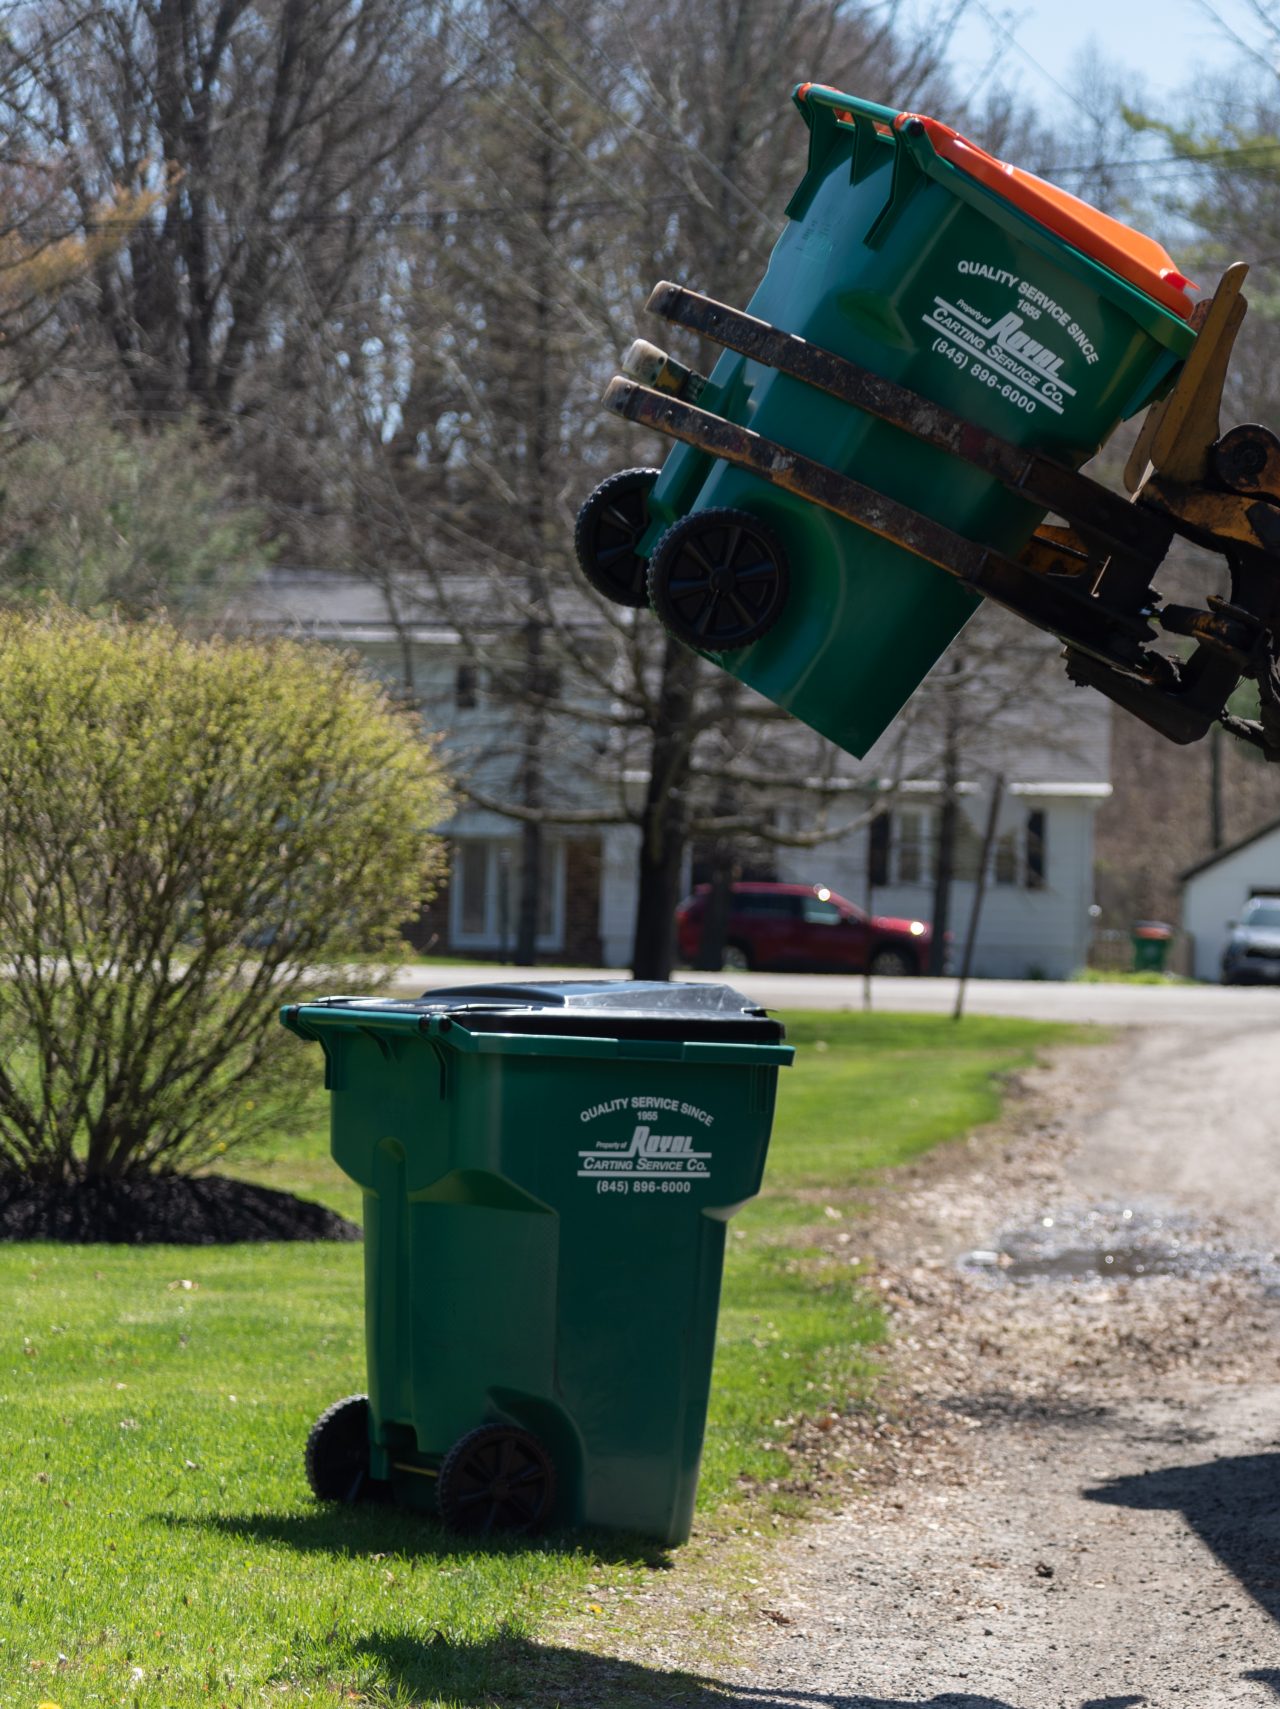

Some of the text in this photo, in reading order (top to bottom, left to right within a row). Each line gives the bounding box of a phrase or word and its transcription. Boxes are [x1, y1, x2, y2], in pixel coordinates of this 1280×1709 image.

[957, 260, 1100, 365] QUALITY SERVICE SINCE
[1016, 299, 1043, 320] 1955
[933, 307, 986, 350] CARTING
[986, 344, 1041, 387] SERVICE
[956, 299, 1065, 377] Property of ROYAL
[931, 337, 1037, 414] (845) 896-6000
[580, 1096, 714, 1127] QUALITY SERVICE SINCE
[637, 1111, 658, 1121] 1955
[596, 1125, 694, 1156] Property of ROYAL
[583, 1157, 633, 1170] CARTING
[636, 1158, 683, 1170] SERVICE
[596, 1180, 691, 1194] (845) 896-6000
